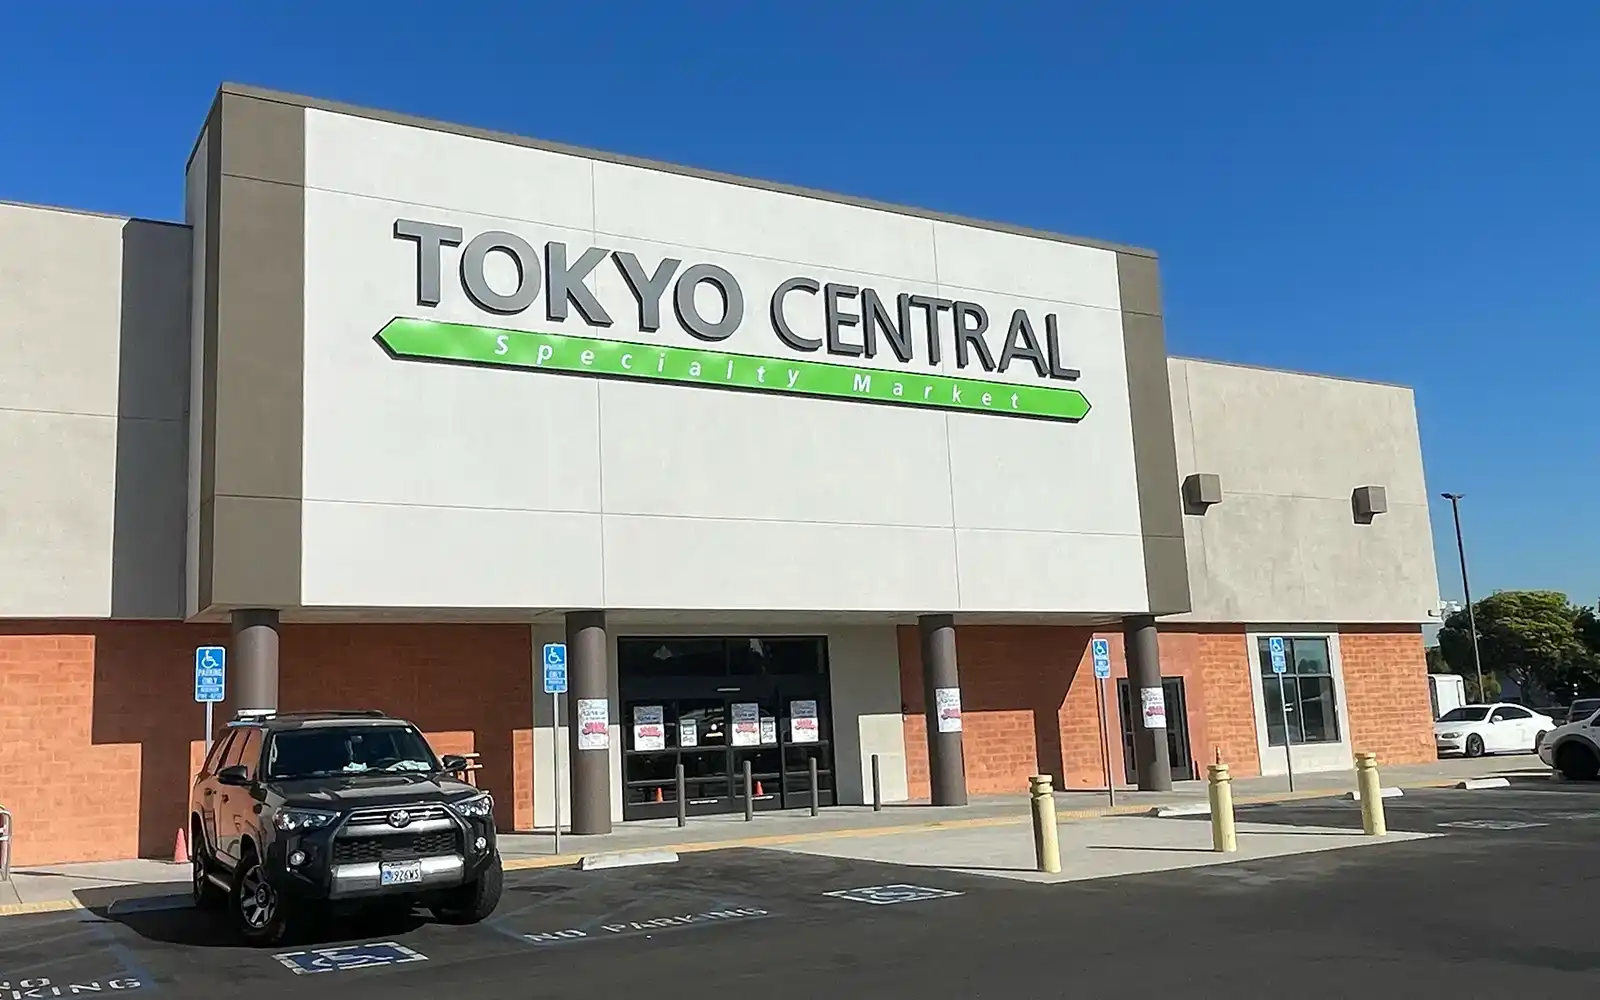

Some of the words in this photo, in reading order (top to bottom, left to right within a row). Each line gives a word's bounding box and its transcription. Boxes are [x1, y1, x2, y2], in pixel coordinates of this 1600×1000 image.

[393, 218, 744, 341] TOKYO
[770, 277, 1080, 381] CENTRAL
[494, 335, 799, 388] Specialty
[853, 373, 1021, 409] Market
[524, 928, 587, 942] NO
[601, 908, 768, 933] PARKING
